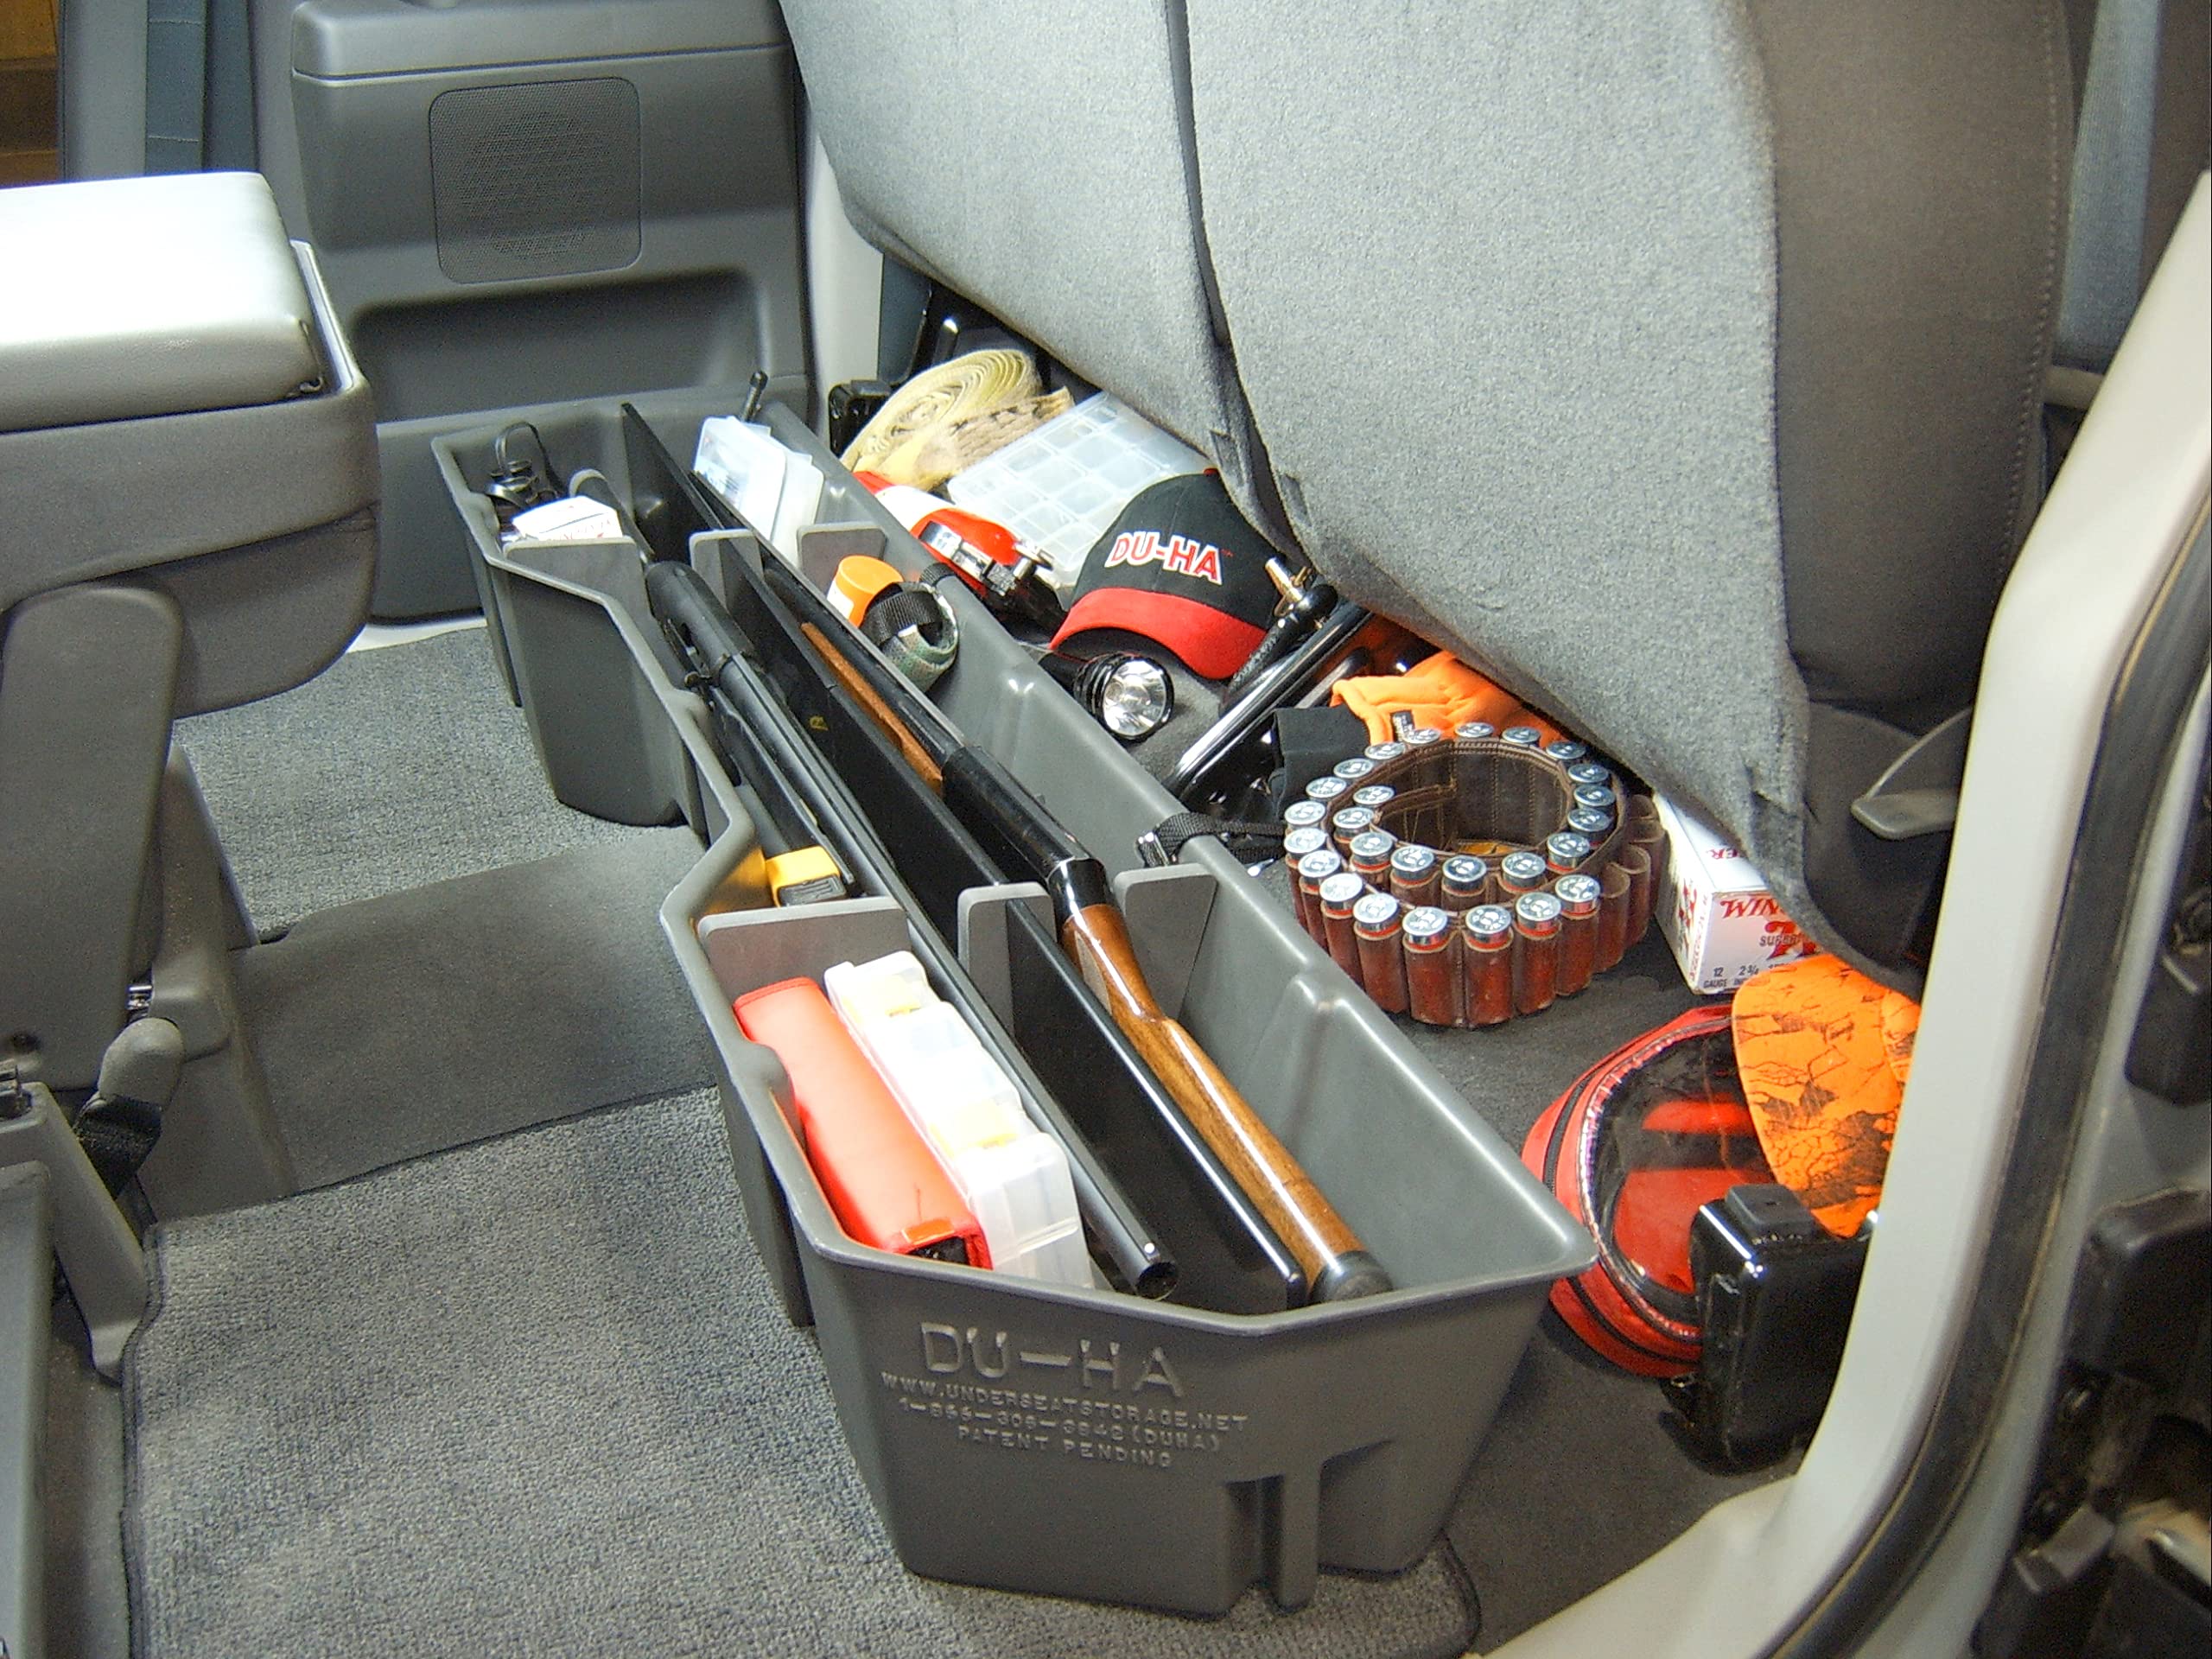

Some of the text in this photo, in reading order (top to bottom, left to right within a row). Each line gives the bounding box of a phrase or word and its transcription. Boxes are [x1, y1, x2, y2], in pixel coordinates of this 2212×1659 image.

[1105, 531, 1222, 585] DU-HA
[1719, 895, 1785, 918] WIN
[1713, 967, 1724, 977] 12
[921, 1321, 1184, 1398] DU-HA
[958, 1425, 1172, 1468] PATENT PENDING
